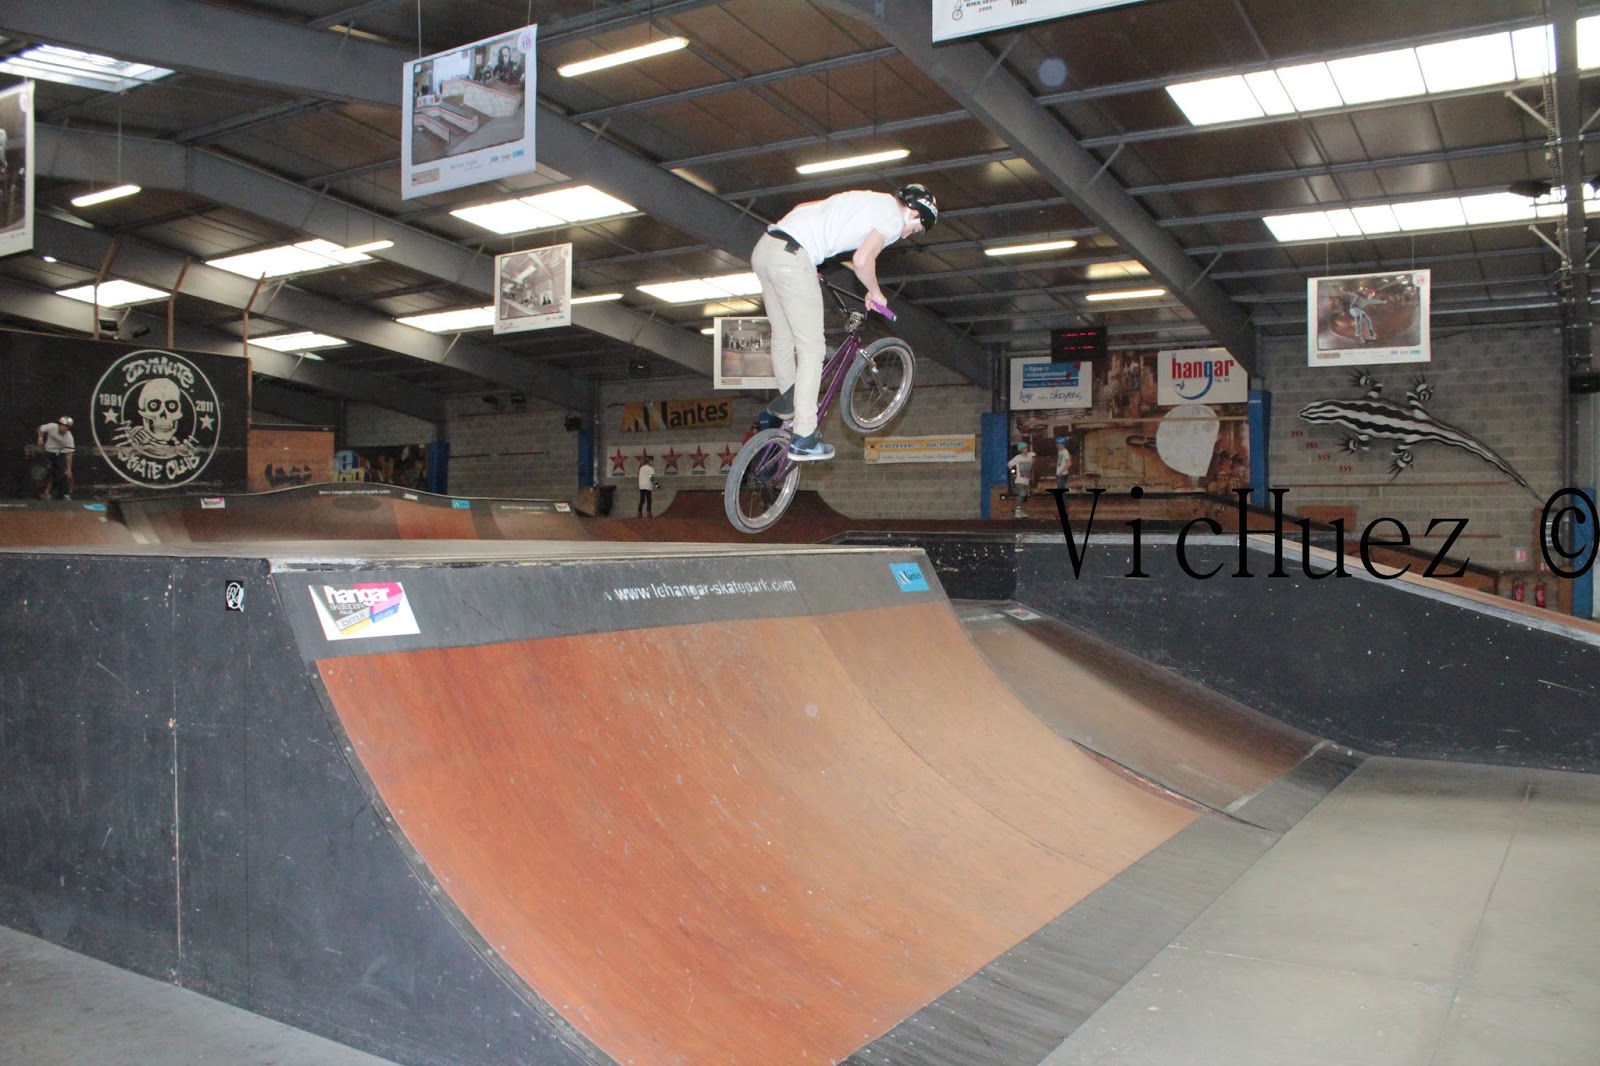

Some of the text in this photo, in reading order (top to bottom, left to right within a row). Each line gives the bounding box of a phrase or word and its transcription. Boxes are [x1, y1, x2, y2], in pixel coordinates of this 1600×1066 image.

[1171, 357, 1235, 393] hangar
[99, 393, 122, 407] 1991
[195, 400, 213, 413] 2011
[165, 450, 200, 480] CLUB
[323, 585, 391, 606] hangar
[614, 577, 797, 600] wwwlehangar-skatepark.com
